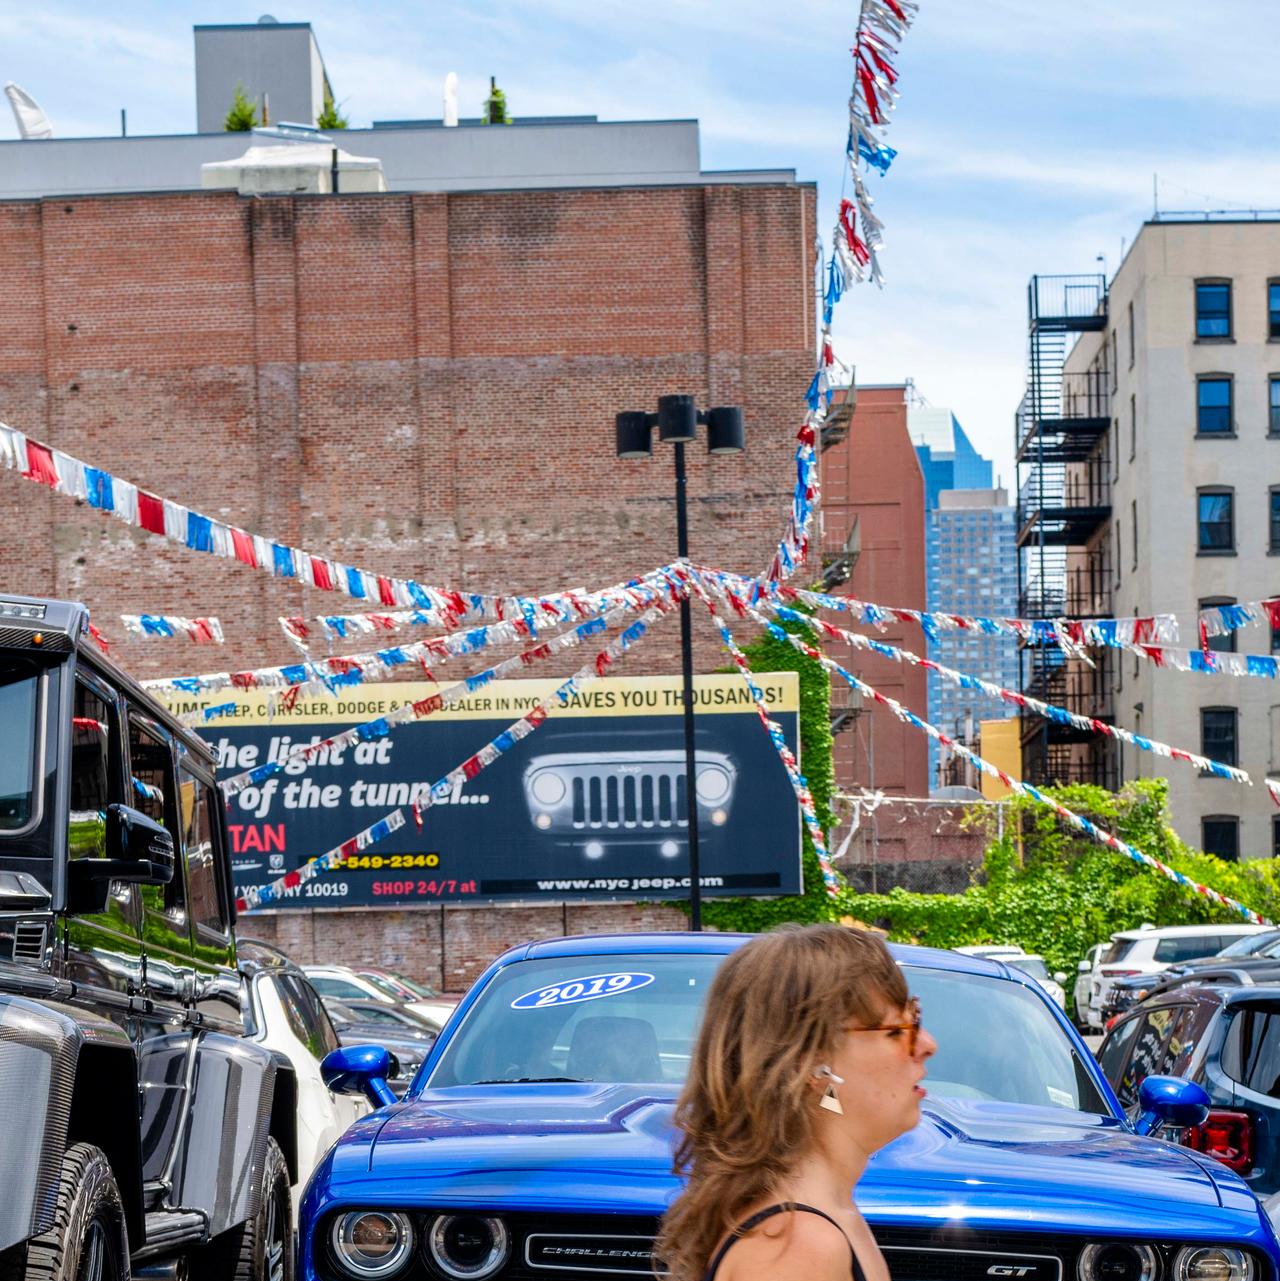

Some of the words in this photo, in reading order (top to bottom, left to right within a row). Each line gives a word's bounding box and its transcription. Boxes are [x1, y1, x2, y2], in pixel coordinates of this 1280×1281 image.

[338, 700, 385, 714] DODGE
[496, 698, 510, 710] IN
[558, 691, 616, 708] SAVES
[620, 690, 658, 707] YOU
[663, 687, 784, 706] THUSANS!
[267, 736, 347, 776] light
[354, 737, 394, 765] at
[238, 778, 278, 818] of
[282, 778, 342, 809] the
[307, 854, 439, 870] 2-549-2340
[305, 882, 349, 897] 10019
[372, 881, 412, 895] SHOP
[420, 879, 456, 896] 24/7
[460, 879, 477, 893] at
[535, 975, 633, 1006] 2019
[986, 1264, 1037, 1277] GT
